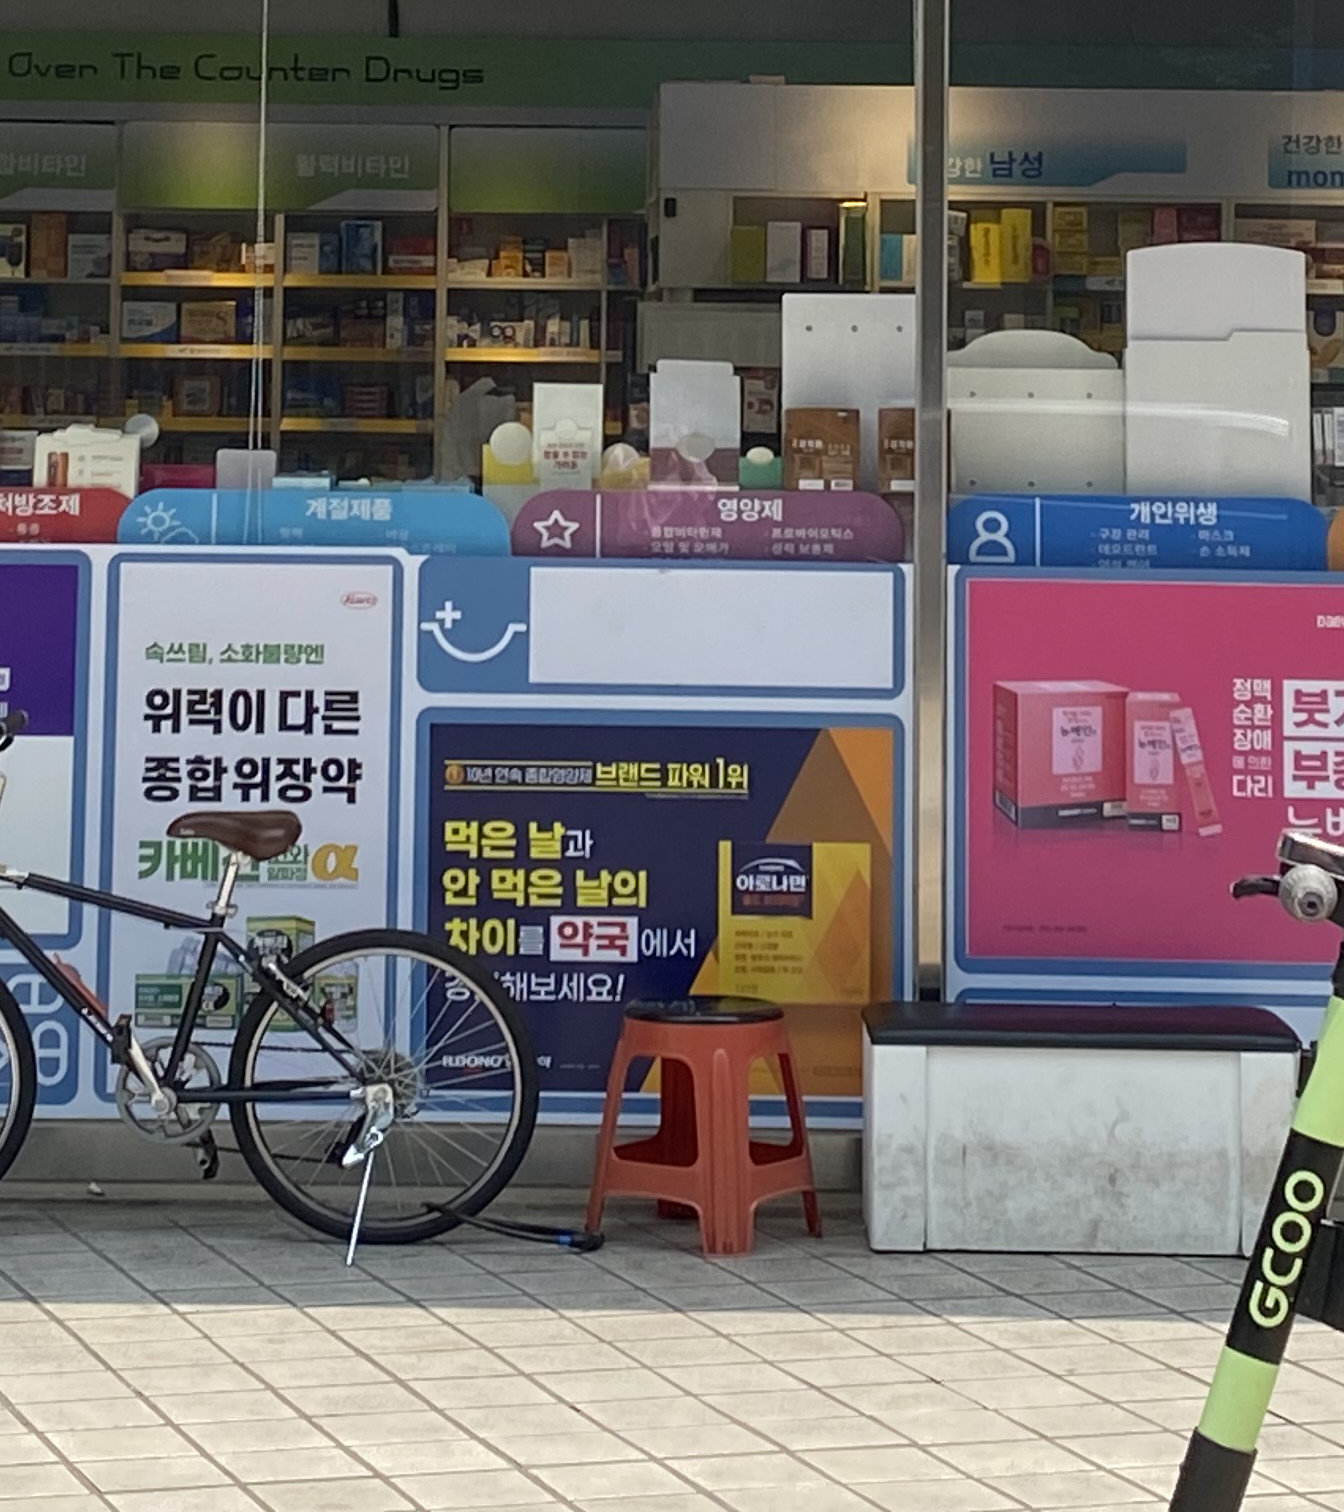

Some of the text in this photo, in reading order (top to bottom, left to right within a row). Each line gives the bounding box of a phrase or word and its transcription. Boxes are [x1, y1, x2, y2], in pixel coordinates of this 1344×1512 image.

[7, 52, 484, 90] Over The Counter Drugs
[1282, 134, 1343, 155] 건강한
[295, 154, 410, 179] 활력비타민
[988, 150, 1044, 179] 남성
[306, 497, 393, 522] 계절제품
[717, 497, 784, 522] 영양제
[1129, 501, 1219, 526] 개인위생
[144, 641, 325, 666] 속쓰림, 소화불량엔
[1232, 678, 1272, 701] 정맥
[143, 688, 361, 736] 위력이 다른
[1232, 703, 1274, 726] 순환
[1232, 728, 1272, 751] 장애
[595, 761, 662, 787] 브랜드
[666, 762, 710, 788] 파워
[715, 757, 749, 789] 1위
[1232, 774, 1273, 798] 다리
[444, 820, 594, 860] 먹은 날과
[441, 868, 649, 908] 안 먹은 날의
[444, 918, 545, 956] 차이를
[1248, 1168, 1325, 1330] GCOO
